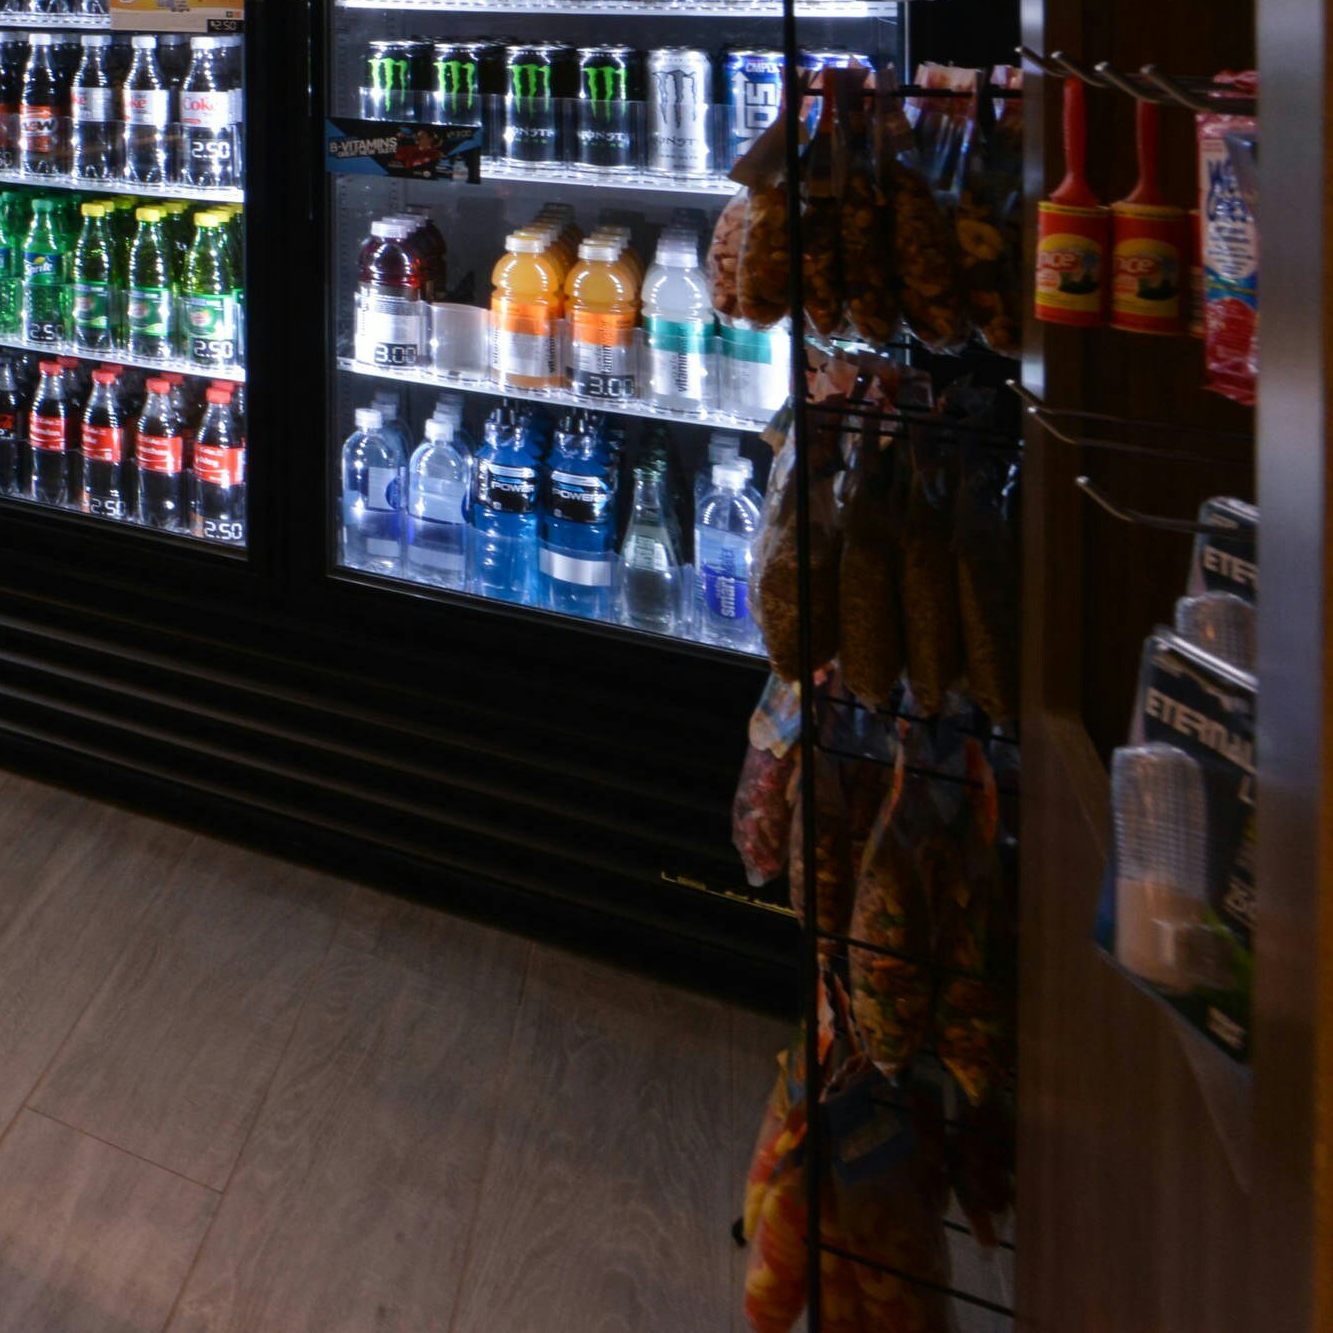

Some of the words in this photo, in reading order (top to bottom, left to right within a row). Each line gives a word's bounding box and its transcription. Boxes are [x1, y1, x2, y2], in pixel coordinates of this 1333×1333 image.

[191, 141, 231, 160] 2.50
[330, 137, 398, 153] B-VITAMINS
[193, 339, 234, 359] 2.50
[374, 343, 417, 364] 3.00
[589, 374, 633, 396] 3.00
[491, 481, 536, 494] POWER
[204, 521, 243, 540] 2.50
[1204, 547, 1259, 590] ETER
